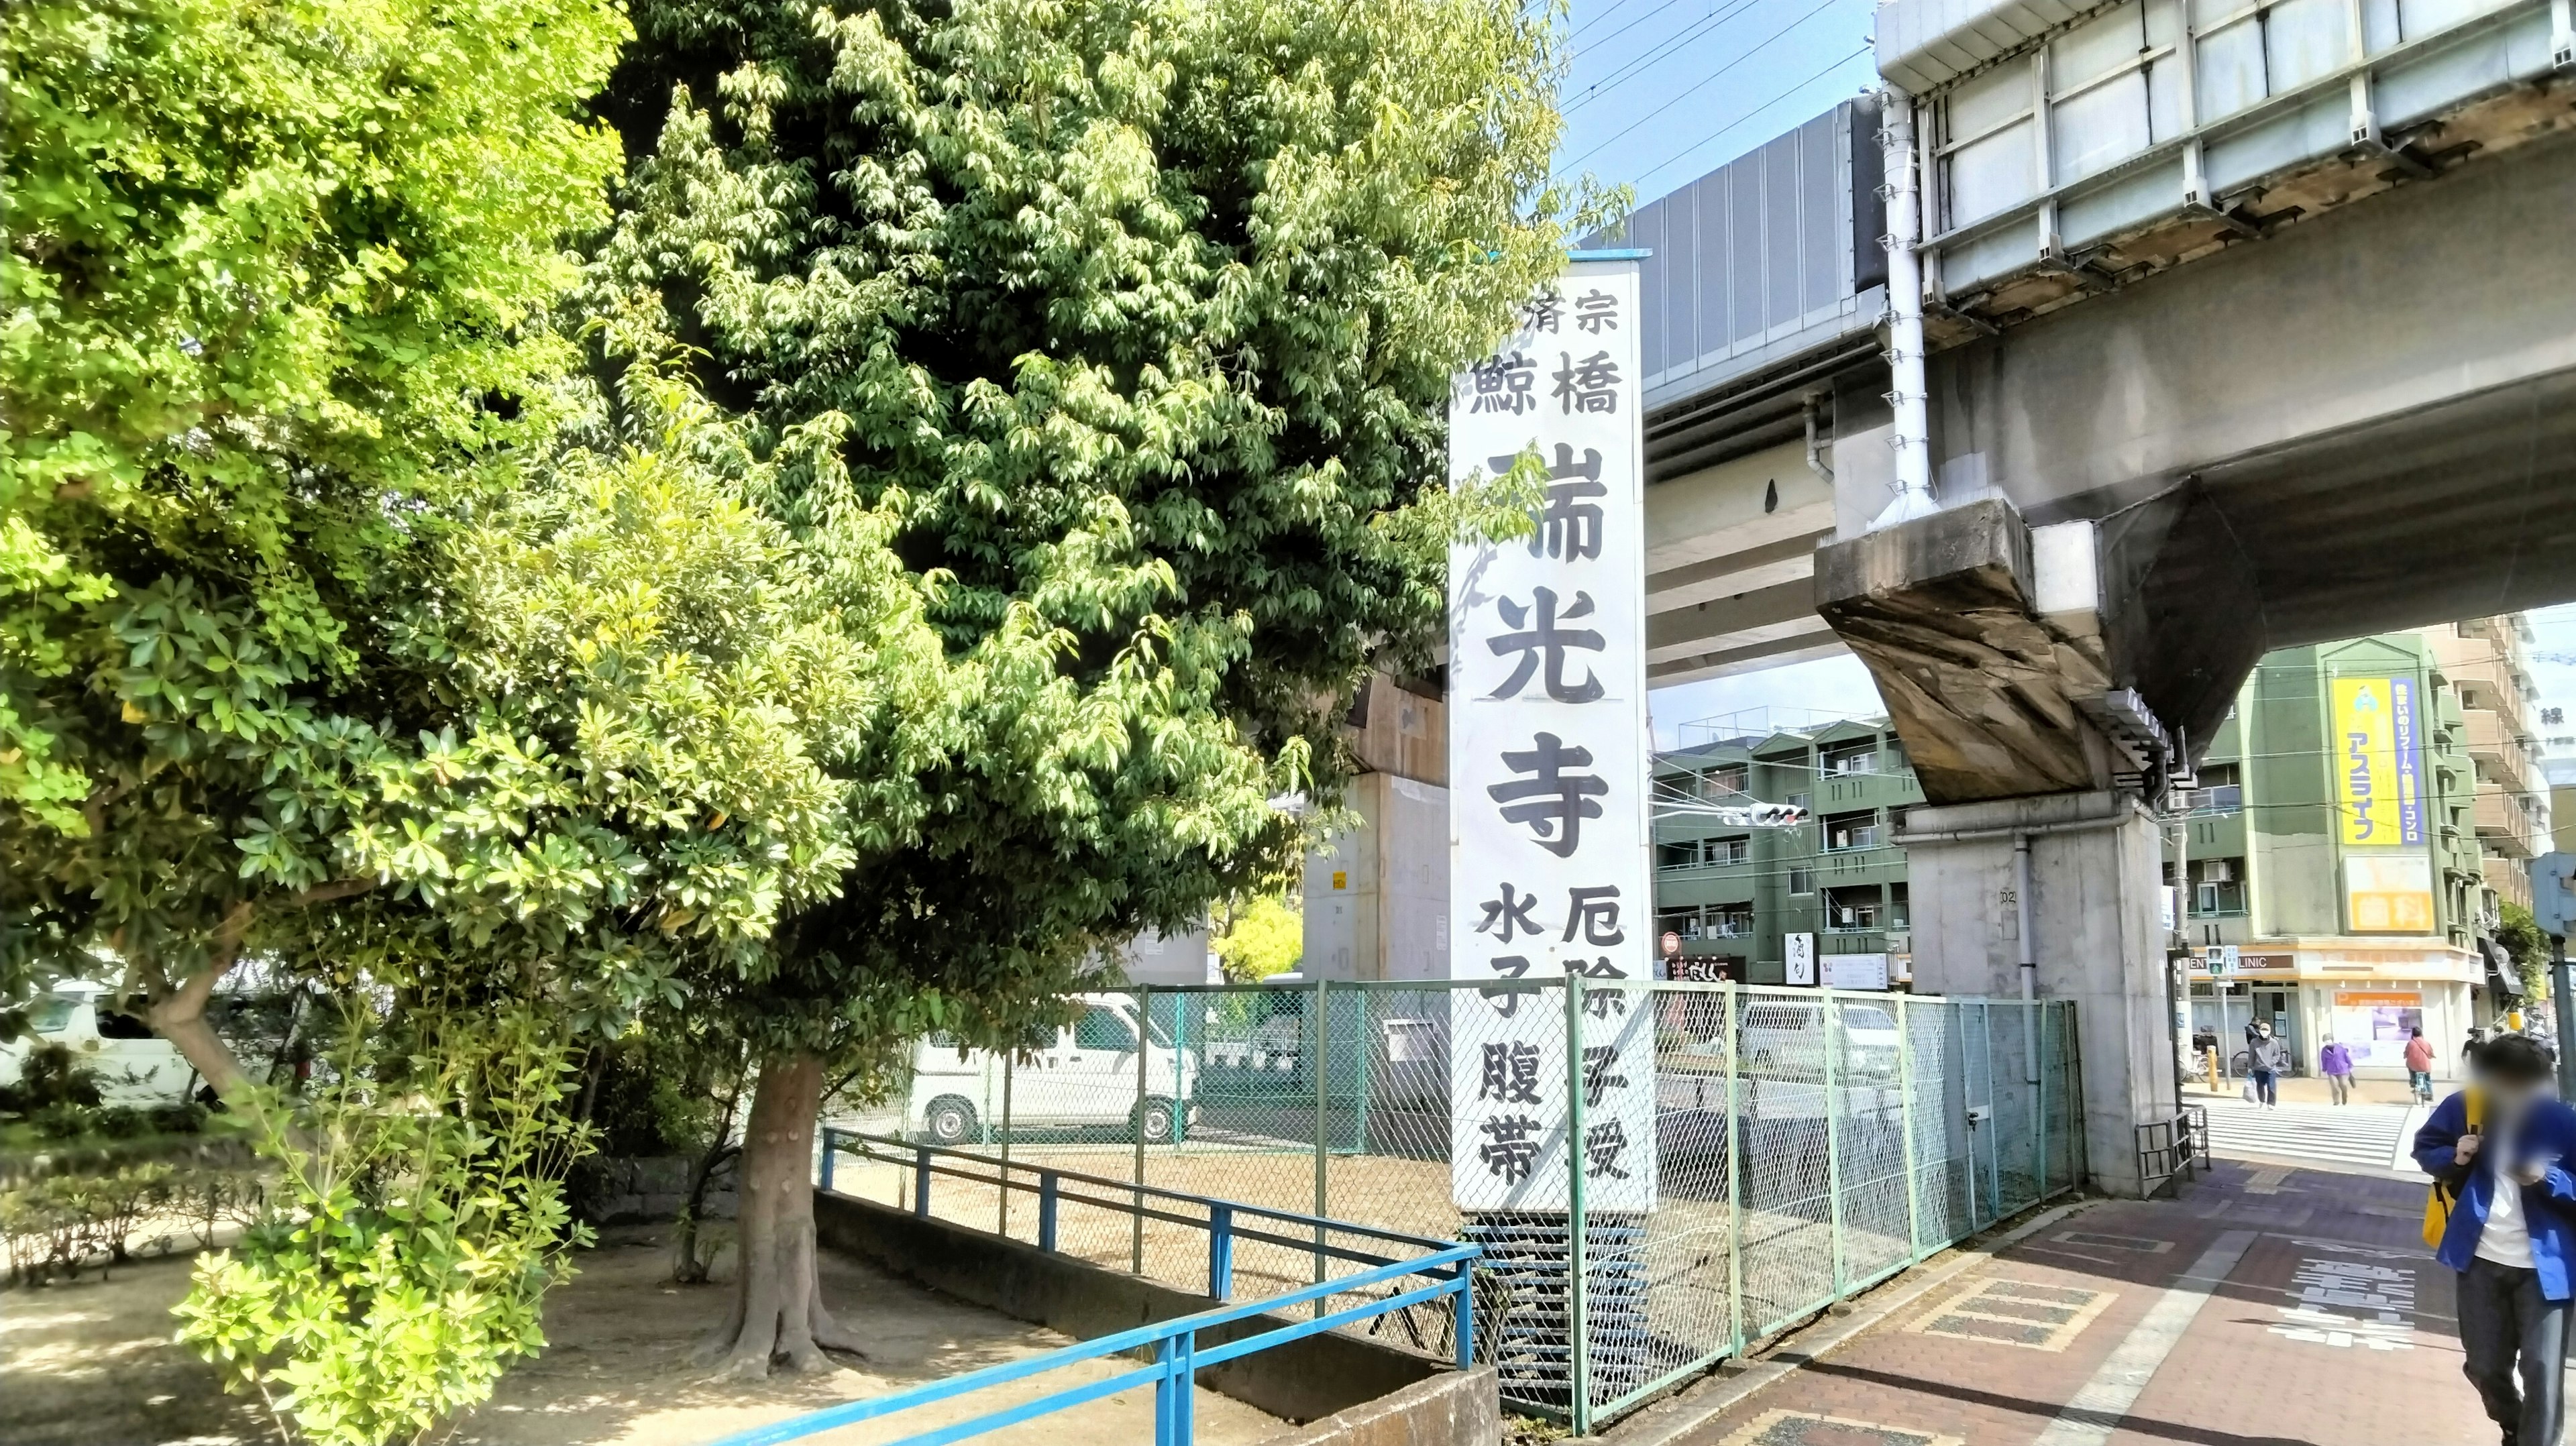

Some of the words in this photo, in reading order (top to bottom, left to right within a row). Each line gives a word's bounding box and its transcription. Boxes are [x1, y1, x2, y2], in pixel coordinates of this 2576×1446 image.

[1470, 350, 1623, 416] 鯨橋
[1487, 442, 1609, 858] 瑞光寺
[2347, 732, 2373, 840] アスライフ
[1474, 882, 1545, 1186] 水子腹帯
